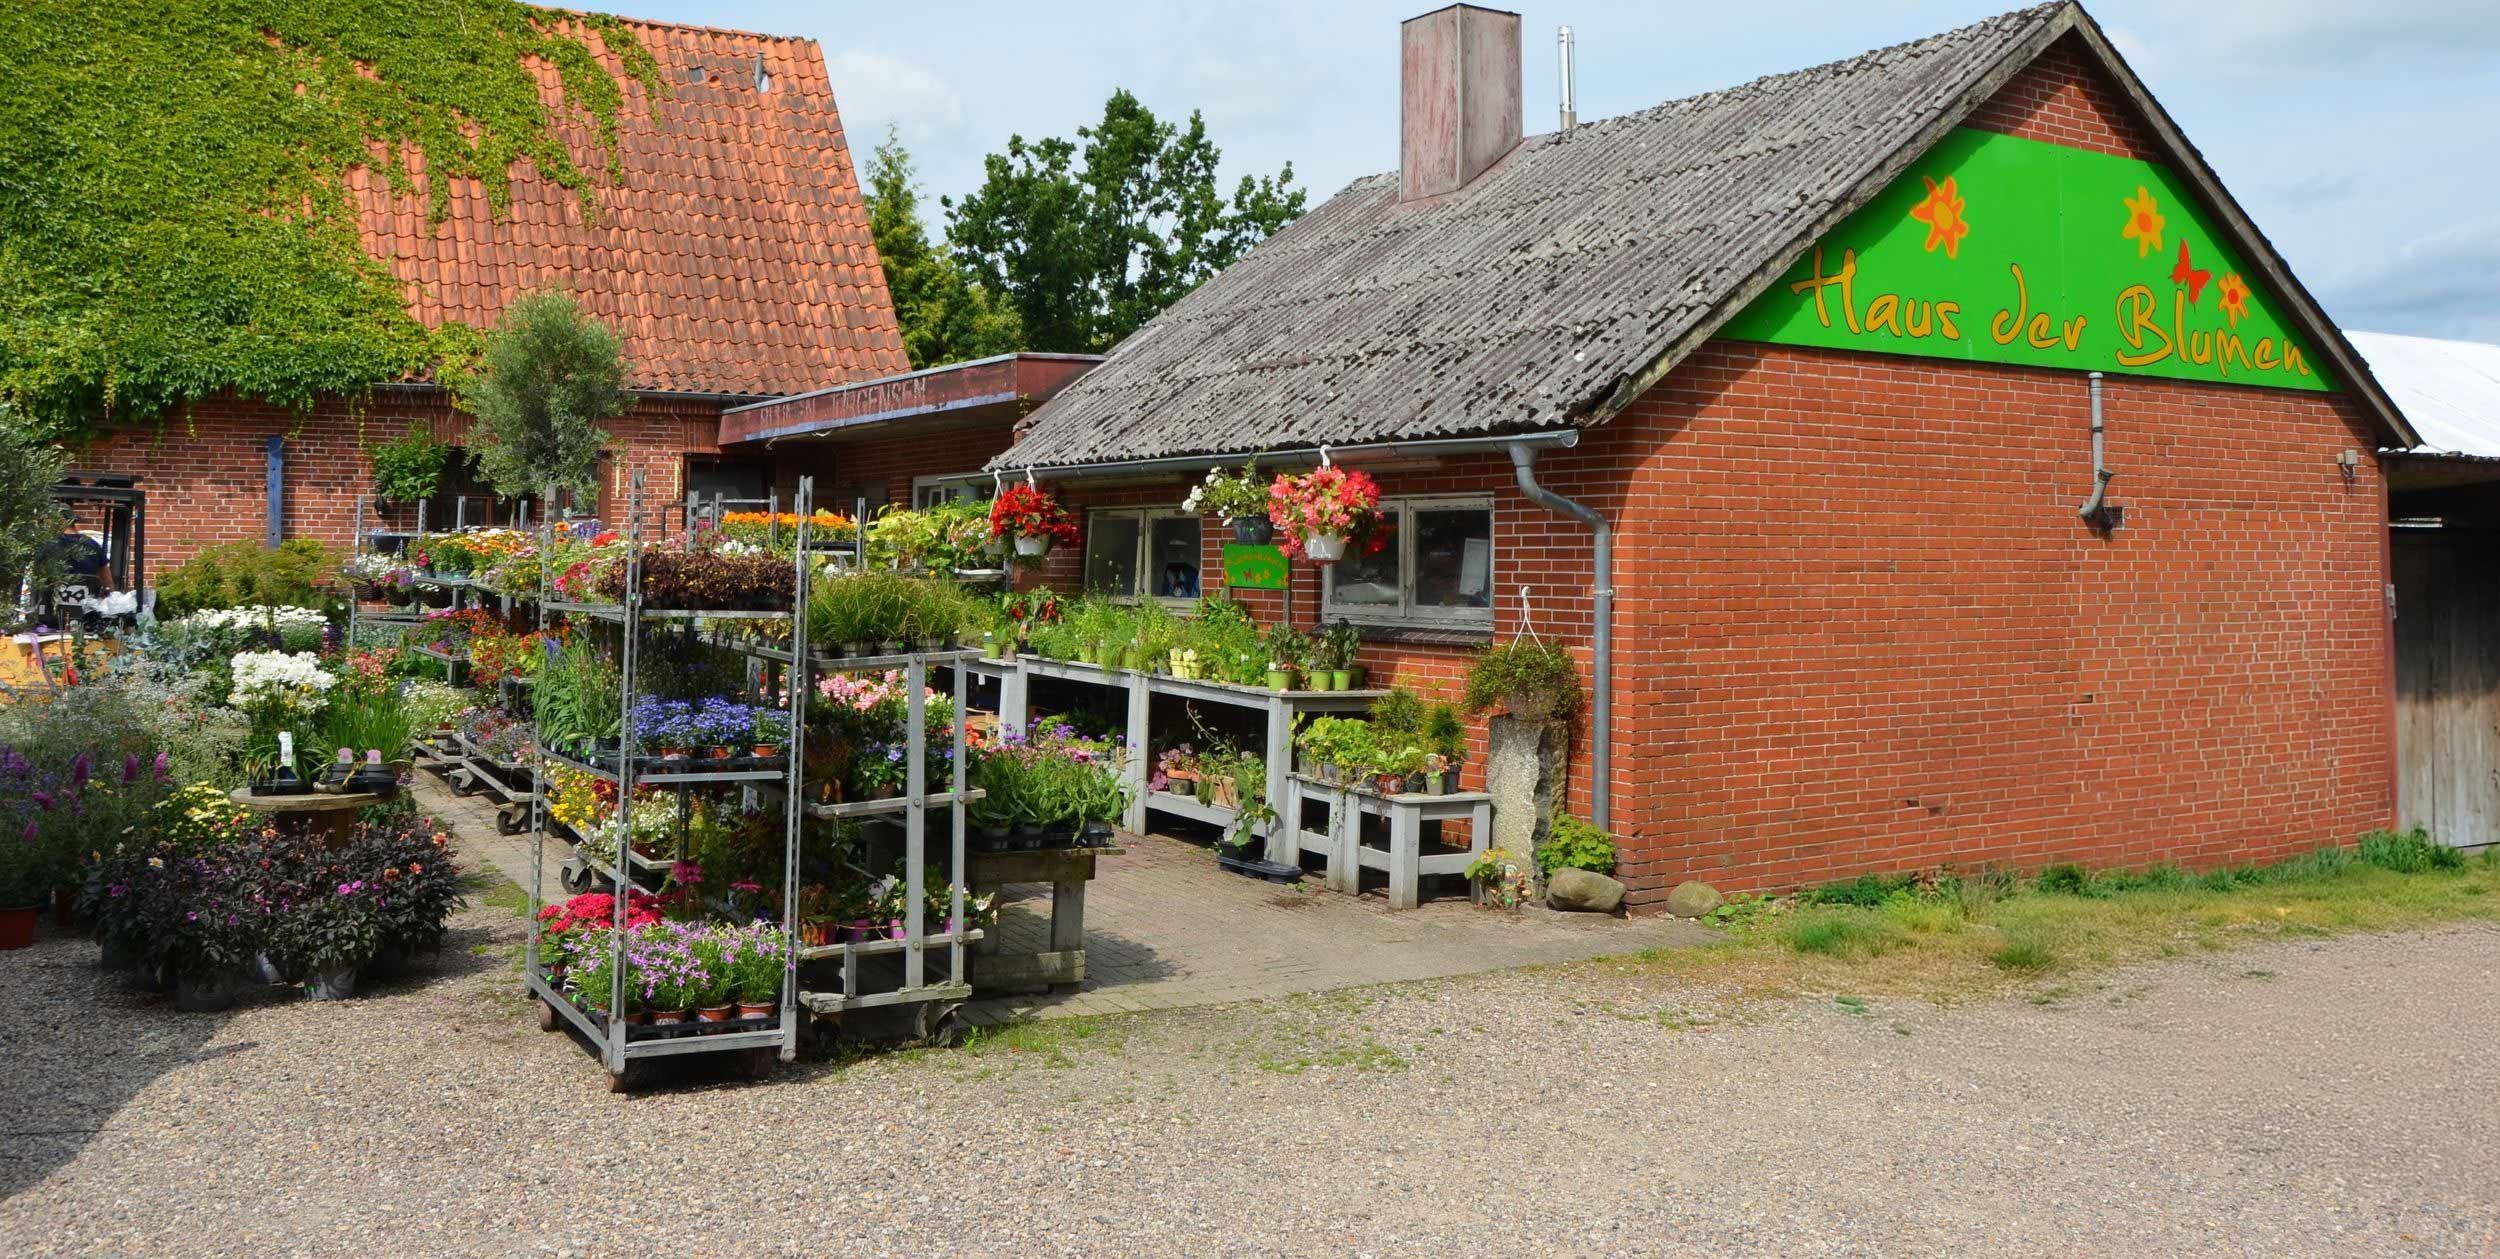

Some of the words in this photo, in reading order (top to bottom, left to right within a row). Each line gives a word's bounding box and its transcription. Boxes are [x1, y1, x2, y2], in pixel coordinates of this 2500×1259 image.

[1790, 245, 1960, 341] Haus
[1991, 263, 2087, 352] der
[2115, 284, 2310, 377] Blumen
